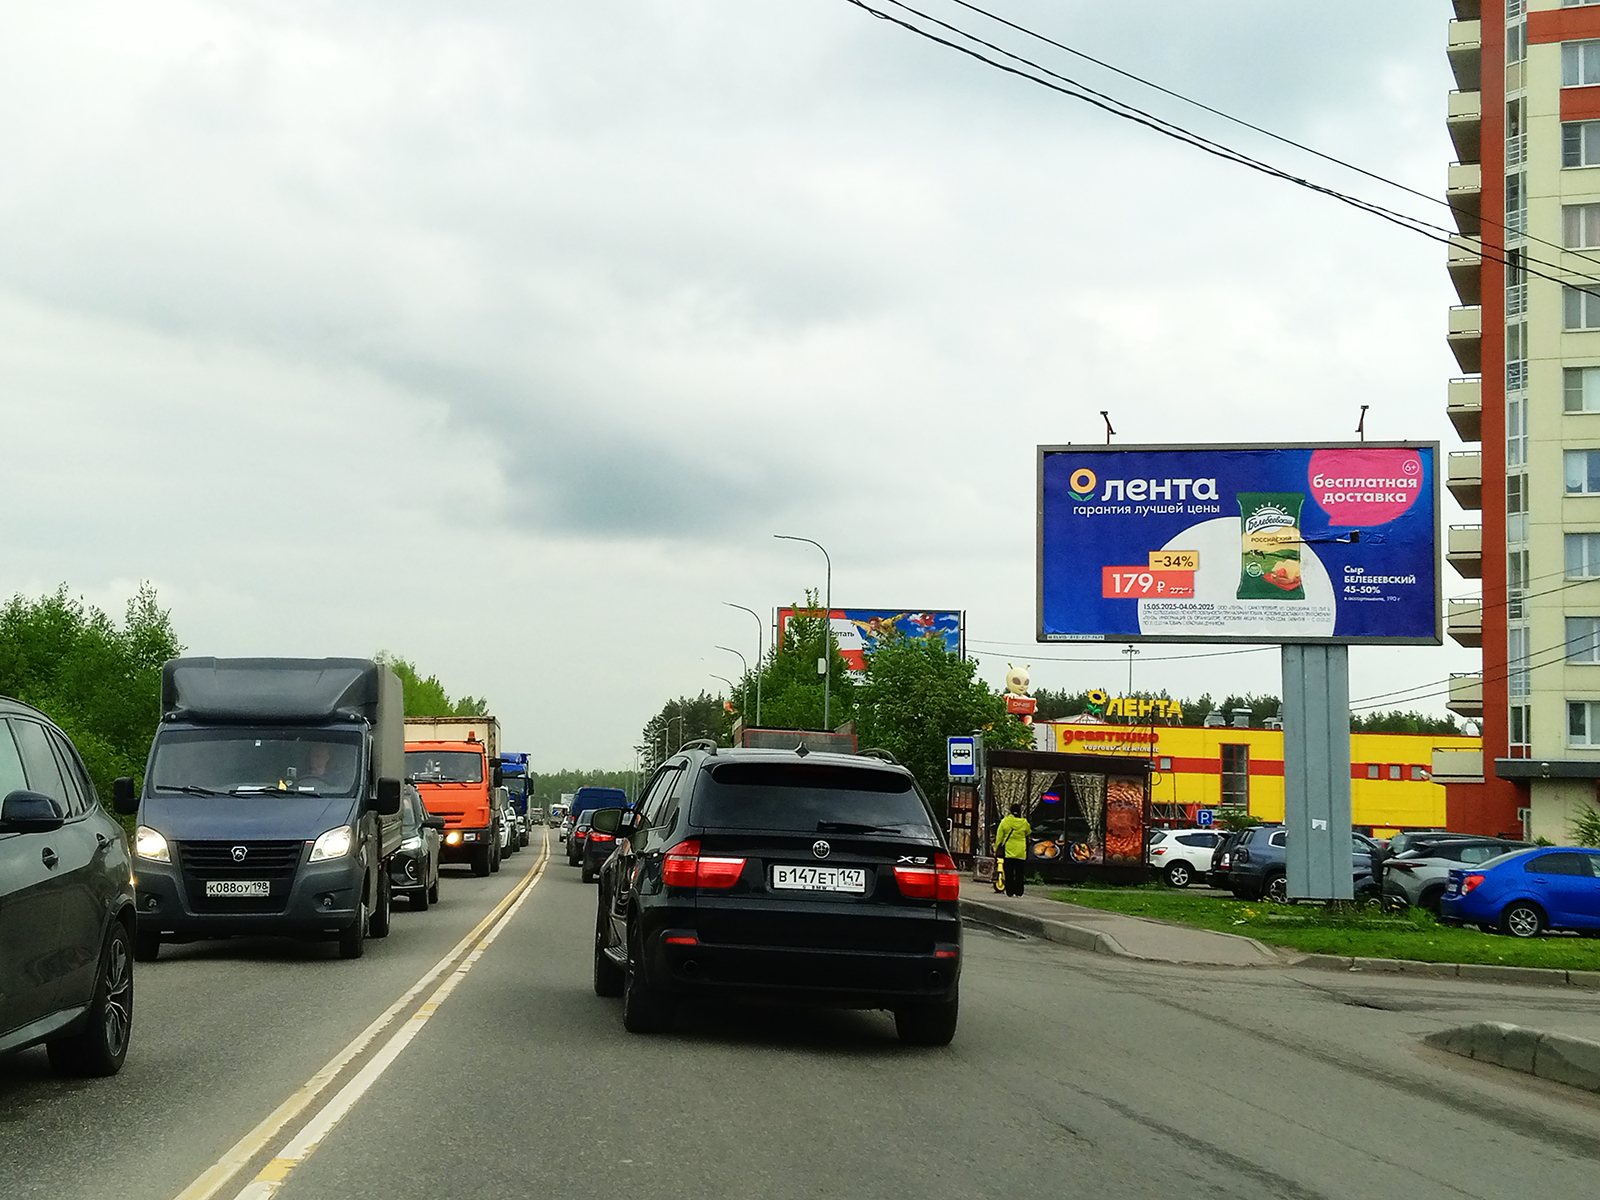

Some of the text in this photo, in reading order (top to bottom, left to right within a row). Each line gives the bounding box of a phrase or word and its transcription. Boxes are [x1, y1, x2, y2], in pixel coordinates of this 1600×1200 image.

[1404, 463, 1417, 472] 6+
[1313, 473, 1418, 488] бесплатная
[1101, 477, 1219, 502] лента
[1322, 492, 1407, 504] доставка
[1073, 502, 1220, 517] гарантия лучшей цены
[1343, 565, 1365, 575] Сыр
[1112, 573, 1154, 593] 179
[1344, 574, 1416, 584] БЕЛЕБЕЕВСКИЙ
[1343, 585, 1381, 594] 45-50%
[1106, 698, 1184, 719] ЛЕНТА
